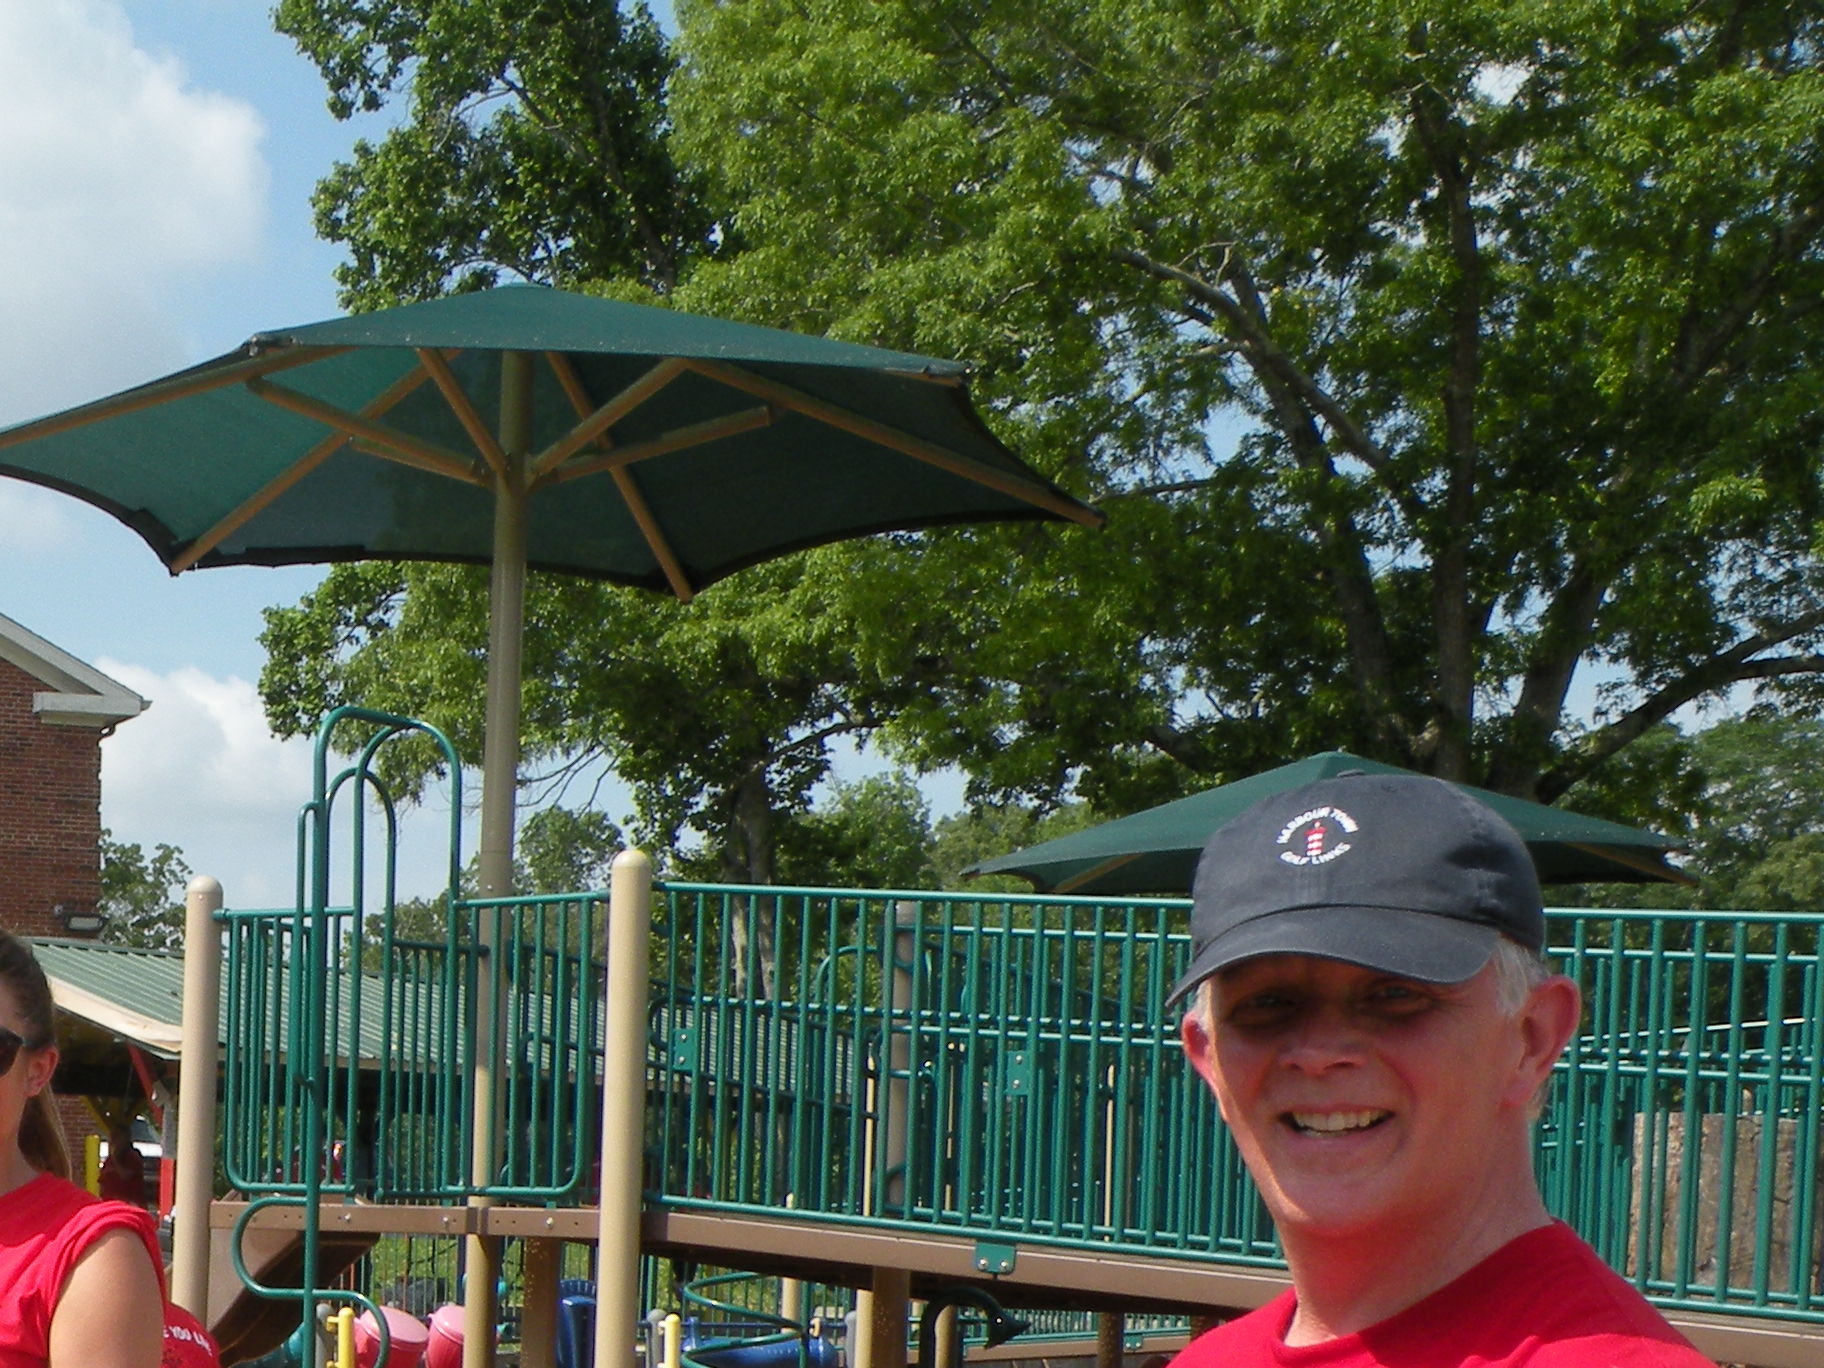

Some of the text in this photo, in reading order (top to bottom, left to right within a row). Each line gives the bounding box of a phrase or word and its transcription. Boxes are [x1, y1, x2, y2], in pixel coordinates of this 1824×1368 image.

[1276, 806, 1359, 844] HARBOUR TOWN
[1280, 842, 1351, 865] GOLF LINKS
